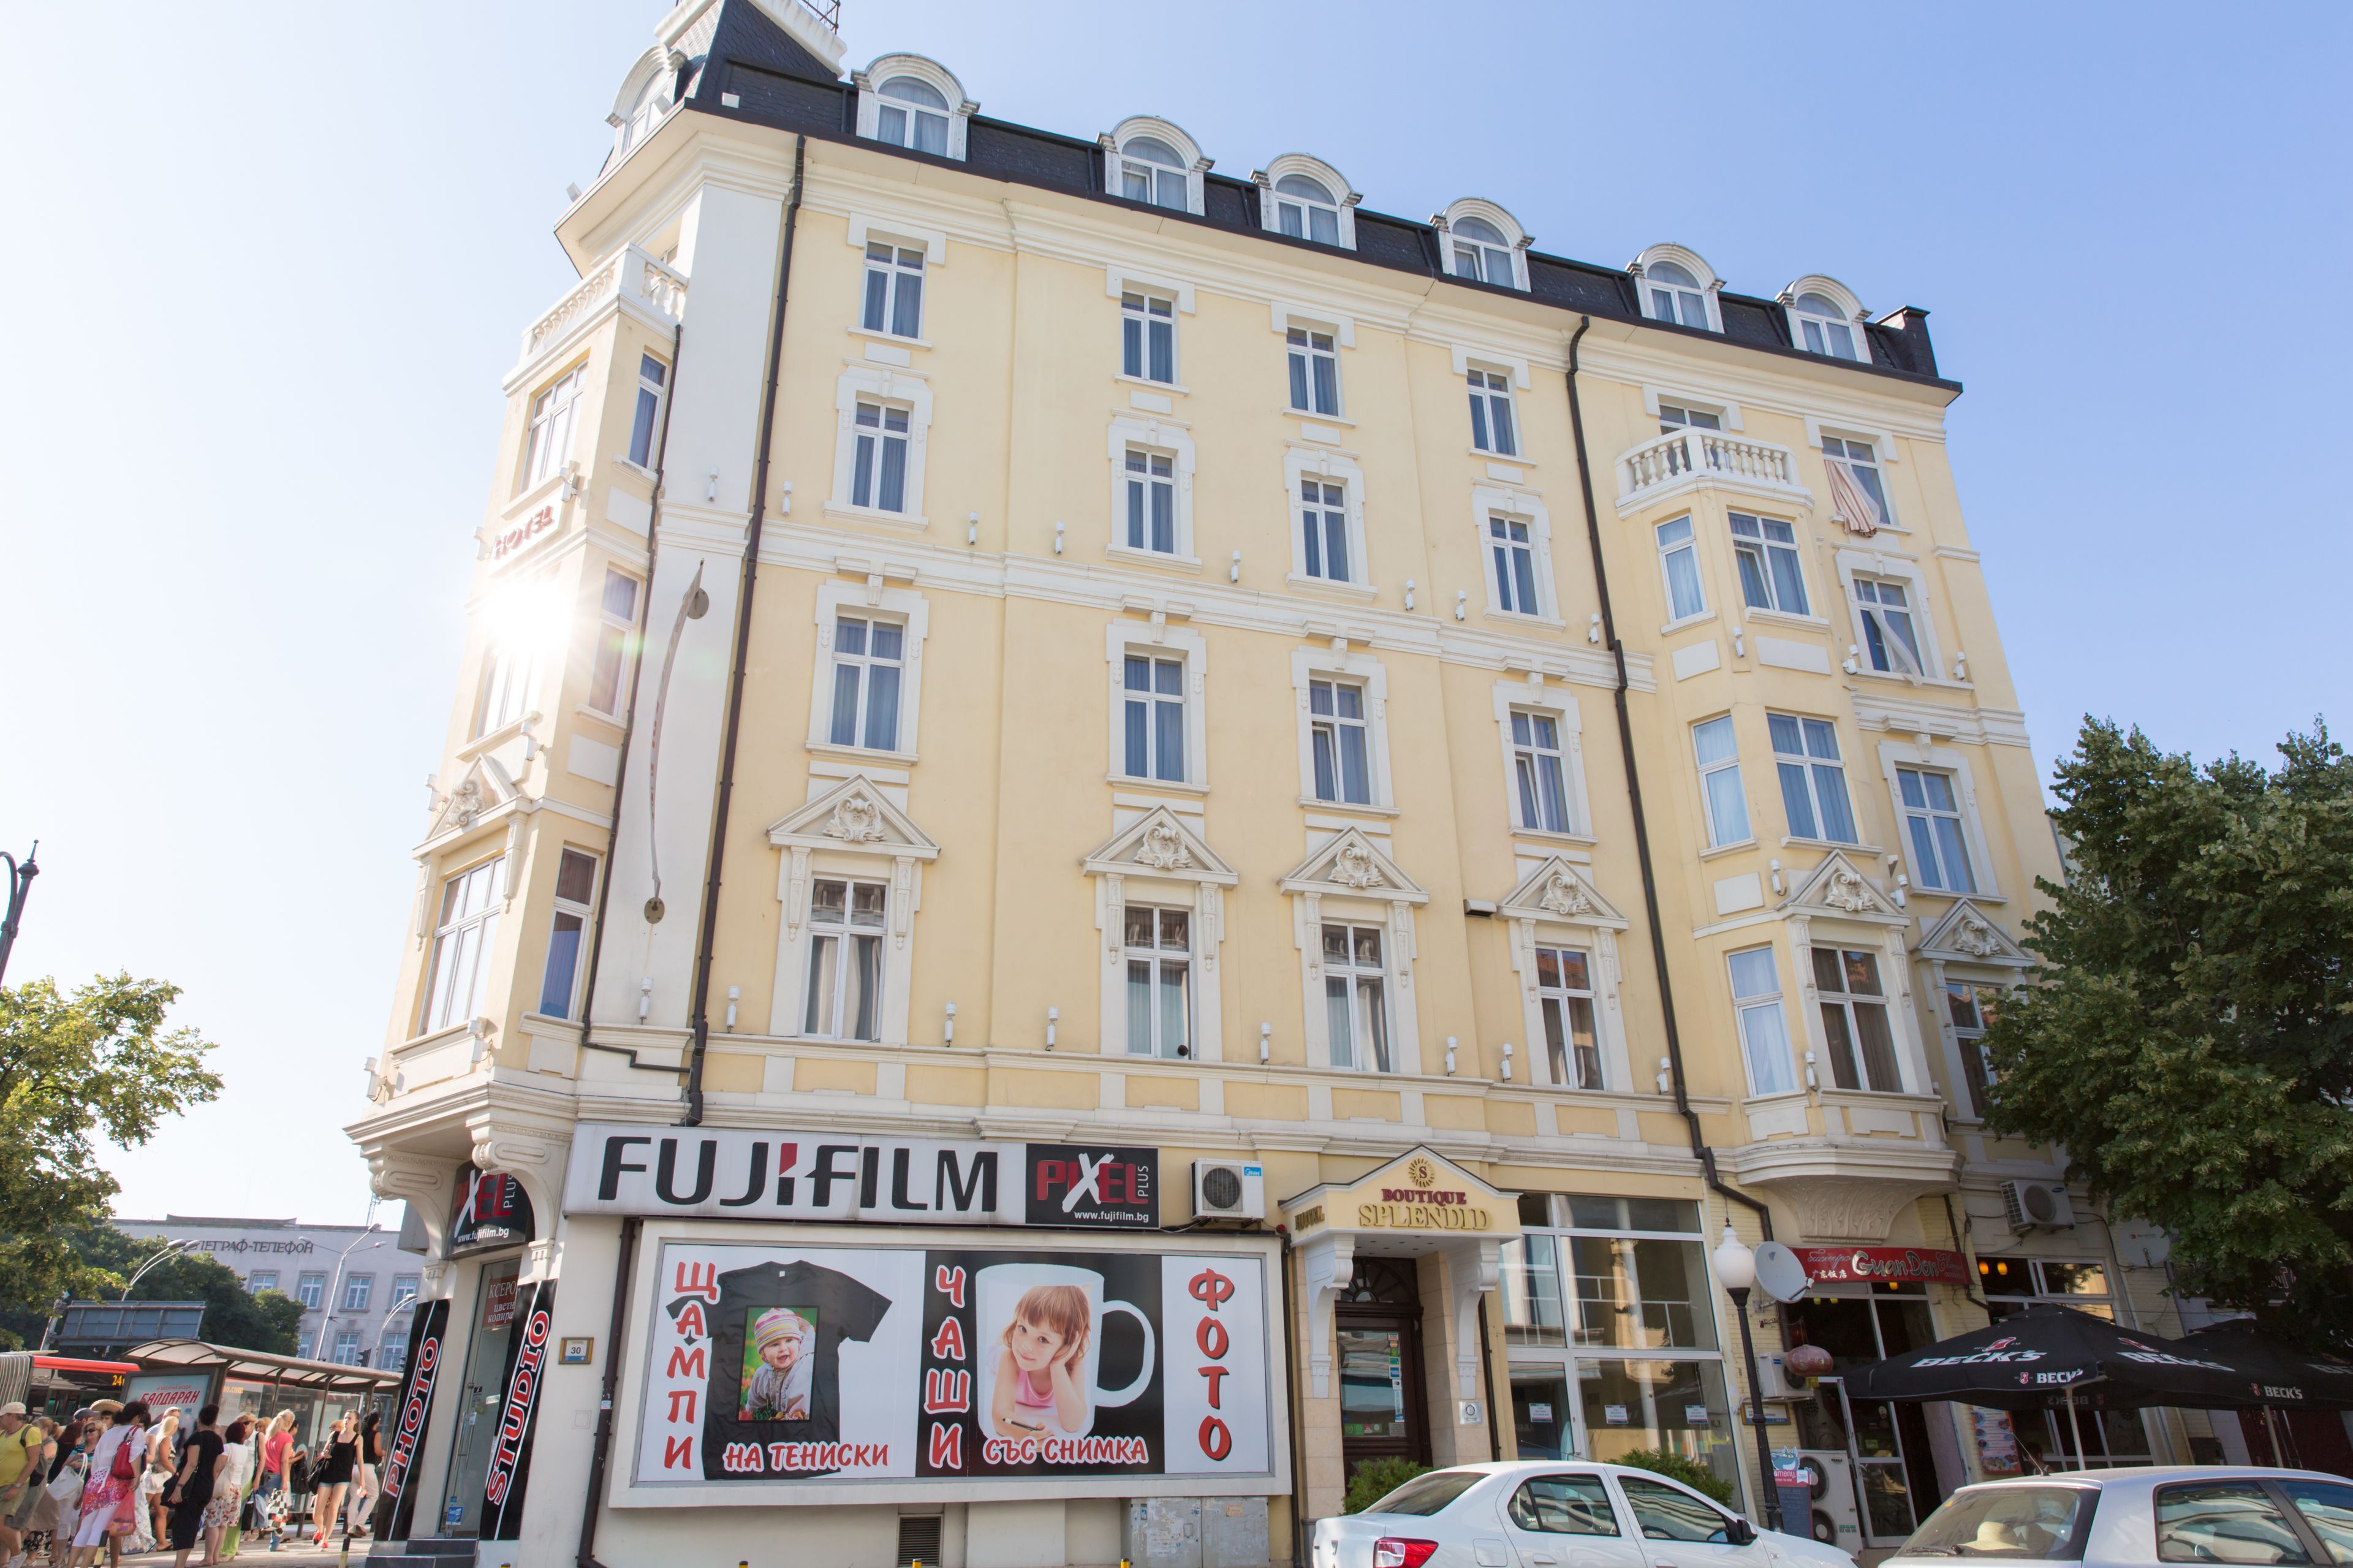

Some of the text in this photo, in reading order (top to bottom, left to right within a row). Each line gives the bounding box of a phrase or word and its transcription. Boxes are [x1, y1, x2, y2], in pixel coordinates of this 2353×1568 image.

[597, 1135, 998, 1212] FUJIFILM
[1037, 1153, 1149, 1213] PIXEL
[1137, 1165, 1149, 1197] PLUS
[1381, 1189, 1467, 1206] BOUTIQUE
[1074, 1211, 1149, 1223] www.fujifilm.bg
[1358, 1203, 1492, 1230] SPLENDID
[458, 1227, 509, 1243] www.fujifilm.bg
[1852, 1251, 1939, 1276] Guan Don
[488, 1281, 517, 1298] КСЕРО
[488, 1312, 514, 1323] копира
[494, 1301, 515, 1312] цветн
[664, 1261, 718, 1470] ЩАМПИ
[926, 1267, 969, 1468] ЧАШИ
[1188, 1268, 1236, 1461] ФОТО
[1910, 1350, 2047, 1368] BECK'S
[2265, 1386, 2303, 1399] BECK'S
[384, 1337, 439, 1498] PHOTO
[487, 1310, 550, 1506] STUDIO
[725, 1443, 889, 1469] НА ТЕНИСКИ
[985, 1437, 1147, 1463] СЪС СНИМКА
